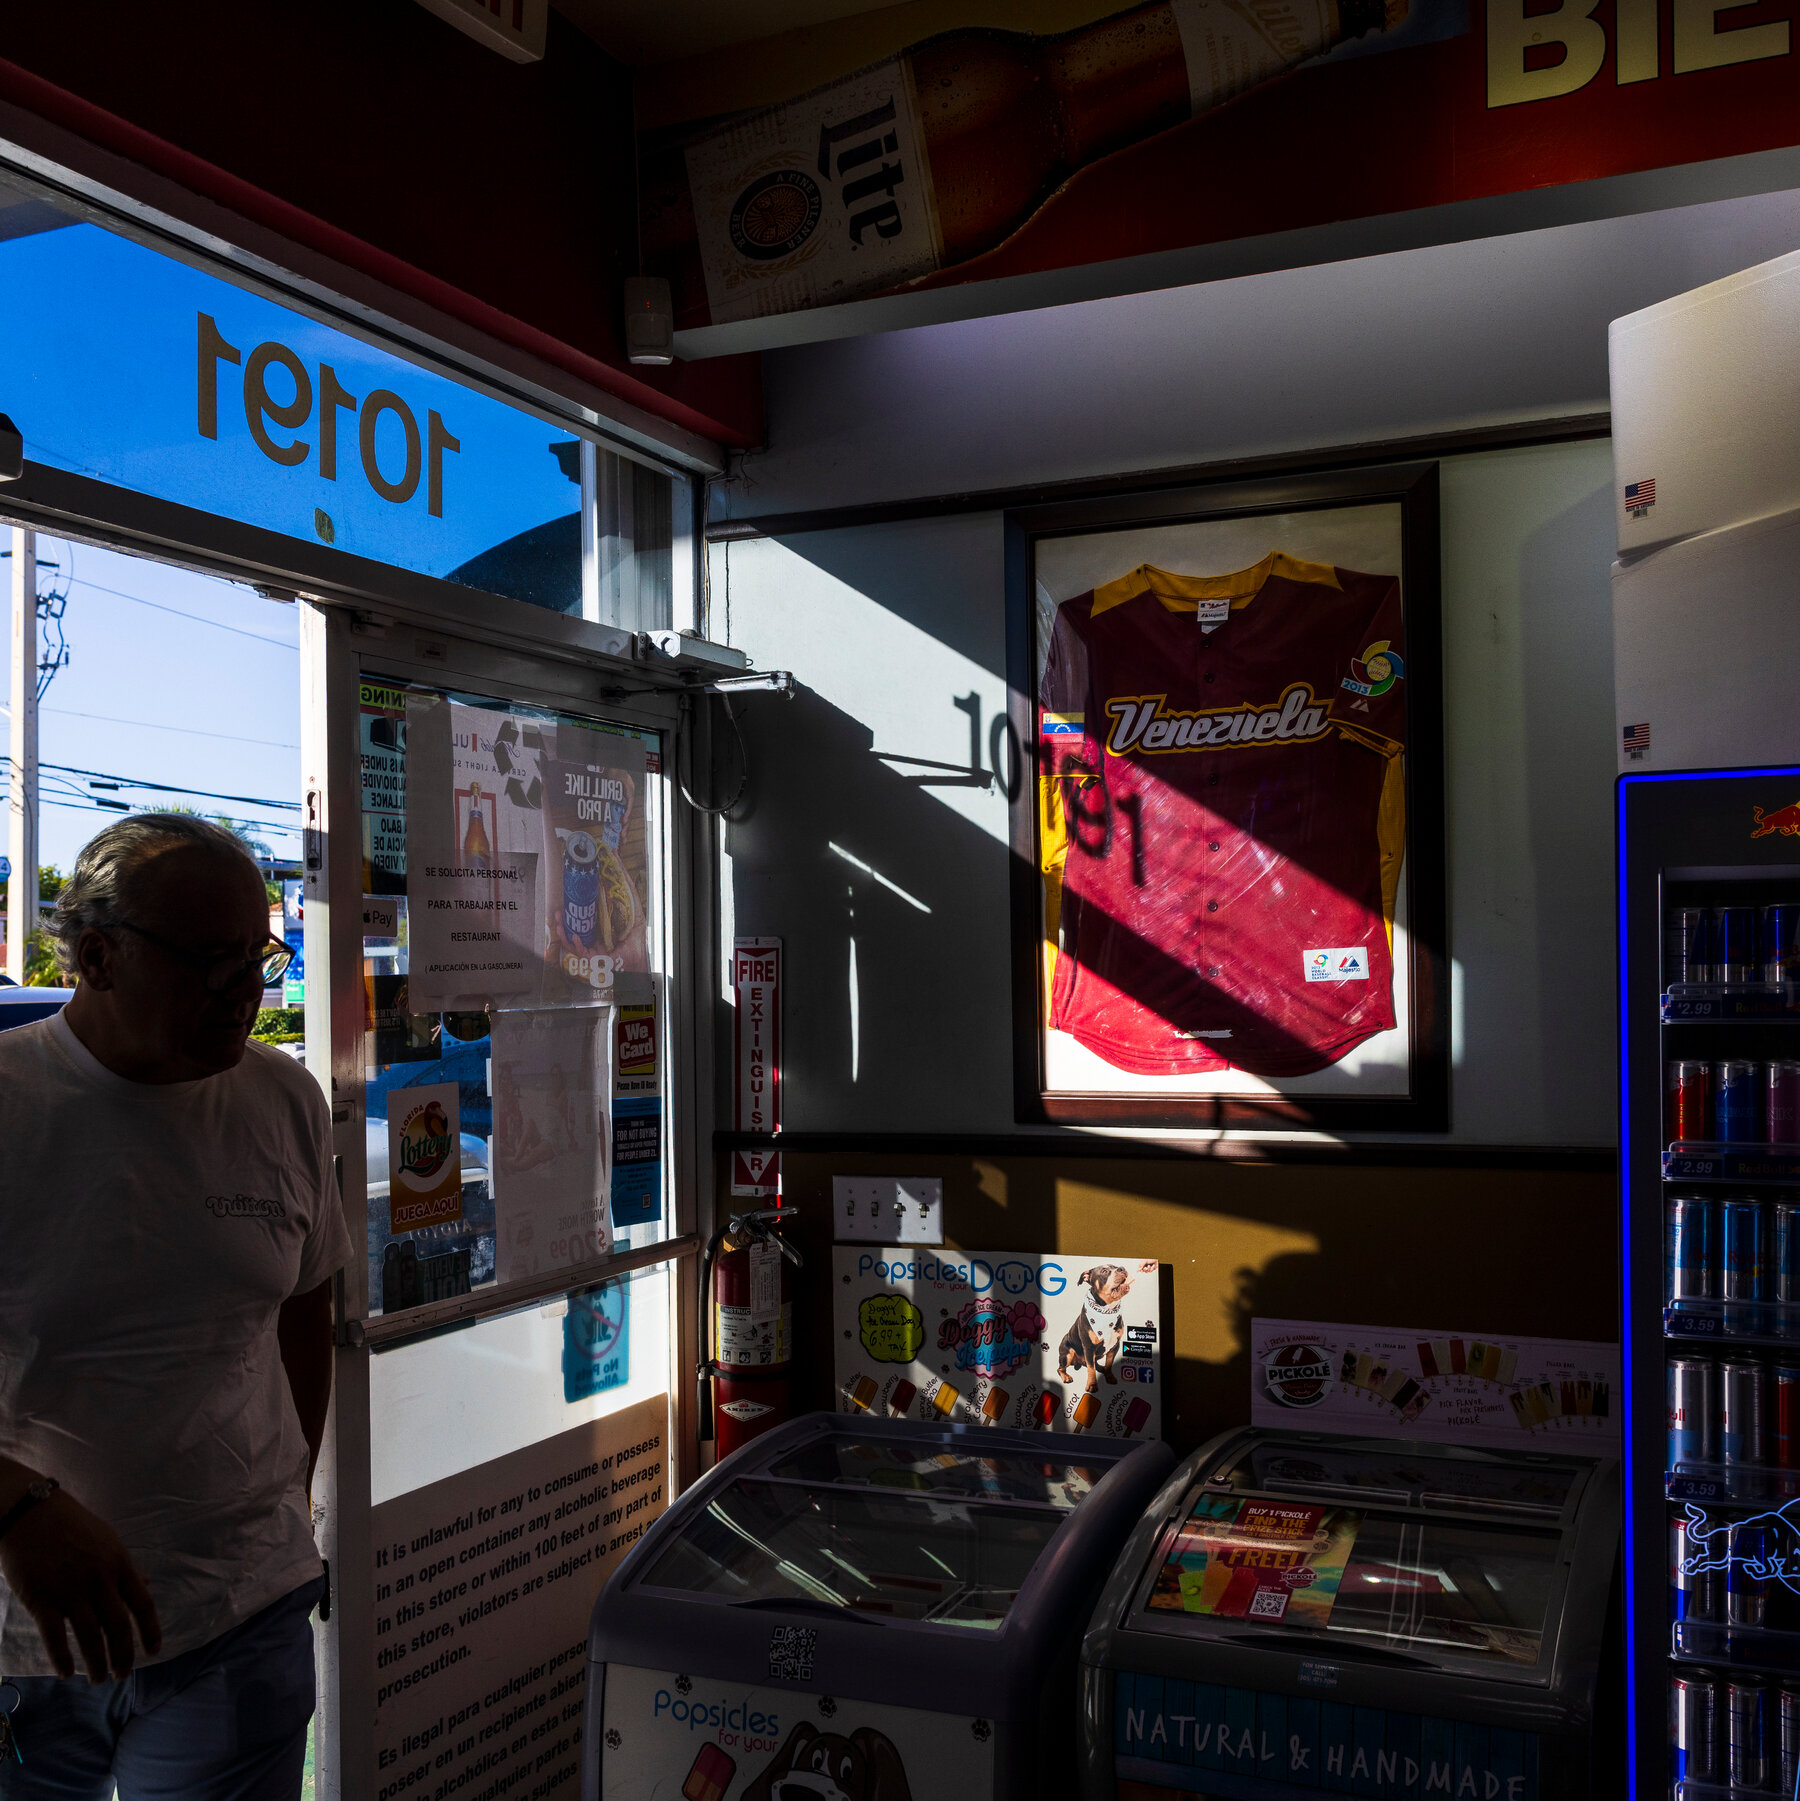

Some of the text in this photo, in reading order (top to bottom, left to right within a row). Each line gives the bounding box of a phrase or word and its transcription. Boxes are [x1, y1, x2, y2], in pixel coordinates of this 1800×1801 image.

[817, 95, 905, 247] Lite
[1343, 679, 1369, 694] 2013
[1110, 690, 1330, 751] Venezuela
[425, 867, 436, 877] SE
[438, 868, 475, 878] SOLICITA
[476, 869, 518, 880] PERSONAL
[372, 910, 392, 928] Pay
[428, 899, 518, 910] PARA TRABAJAR EN EL
[450, 932, 501, 942] RESTAURANT
[428, 963, 470, 973] APLICACIÓN
[739, 960, 775, 982] FIRE
[625, 1023, 649, 1041] We
[619, 1037, 654, 1060] Card
[399, 1104, 425, 1137] FLORIDA
[616, 1130, 628, 1141] FOR
[398, 1133, 452, 1174] Lottery
[1738, 1162, 1760, 1174] Red
[394, 1191, 459, 1224] JUEGA AQUÍ
[409, 1218, 473, 1240] TOYOTA
[858, 1253, 968, 1284] Popsicles
[933, 1281, 968, 1292] for your
[868, 1302, 900, 1316] Doggy
[986, 1303, 1002, 1314] CREAM
[937, 1314, 1009, 1350] Doggy
[845, 1371, 862, 1390] Butter
[922, 1375, 939, 1396] Butter
[1268, 1362, 1331, 1380] PICKOLÉ
[882, 1373, 900, 1417] Strawberry
[926, 1387, 938, 1418] Banana
[965, 1379, 989, 1424] Strawberry
[974, 1391, 988, 1420] Carrot
[1014, 1383, 1038, 1429] Strawberry
[1025, 1392, 1040, 1427] Banana
[1063, 1392, 1080, 1419] Carrot
[1439, 1398, 1484, 1409] PICK FLAVOR
[1473, 1404, 1505, 1413] FRESHNESS
[1104, 1389, 1127, 1438] Watermelon
[1115, 1398, 1129, 1432] Banana
[1447, 1414, 1481, 1426] PICKOLÉ
[376, 1435, 660, 1569] It is unlawful for any to consume or possess
[1247, 1507, 1269, 1517] BUY
[1275, 1510, 1313, 1520] PICKOLÉ
[377, 1461, 661, 1602] in an open container any alcoholic beverage
[1242, 1524, 1305, 1536] PRIZE STICK
[1244, 1515, 1310, 1530] FIND THE
[377, 1484, 663, 1636] in this store or within 100 feet of any part of
[1228, 1547, 1300, 1569] FREE!
[377, 1526, 644, 1669] this store, violators are subject to arrest
[377, 1643, 472, 1707] prosecution.
[378, 1662, 546, 1770] Es ilegal para cualquier
[654, 1689, 780, 1736] Popsicles
[378, 1692, 547, 1801] poseer en un recipiente
[434, 1716, 559, 1801] alcohólica en esta
[536, 1737, 570, 1773] parte
[719, 1728, 779, 1761] for your
[1125, 1706, 1527, 1800] NATURAL & HANDMADE
[531, 1761, 578, 1801] sujetos
